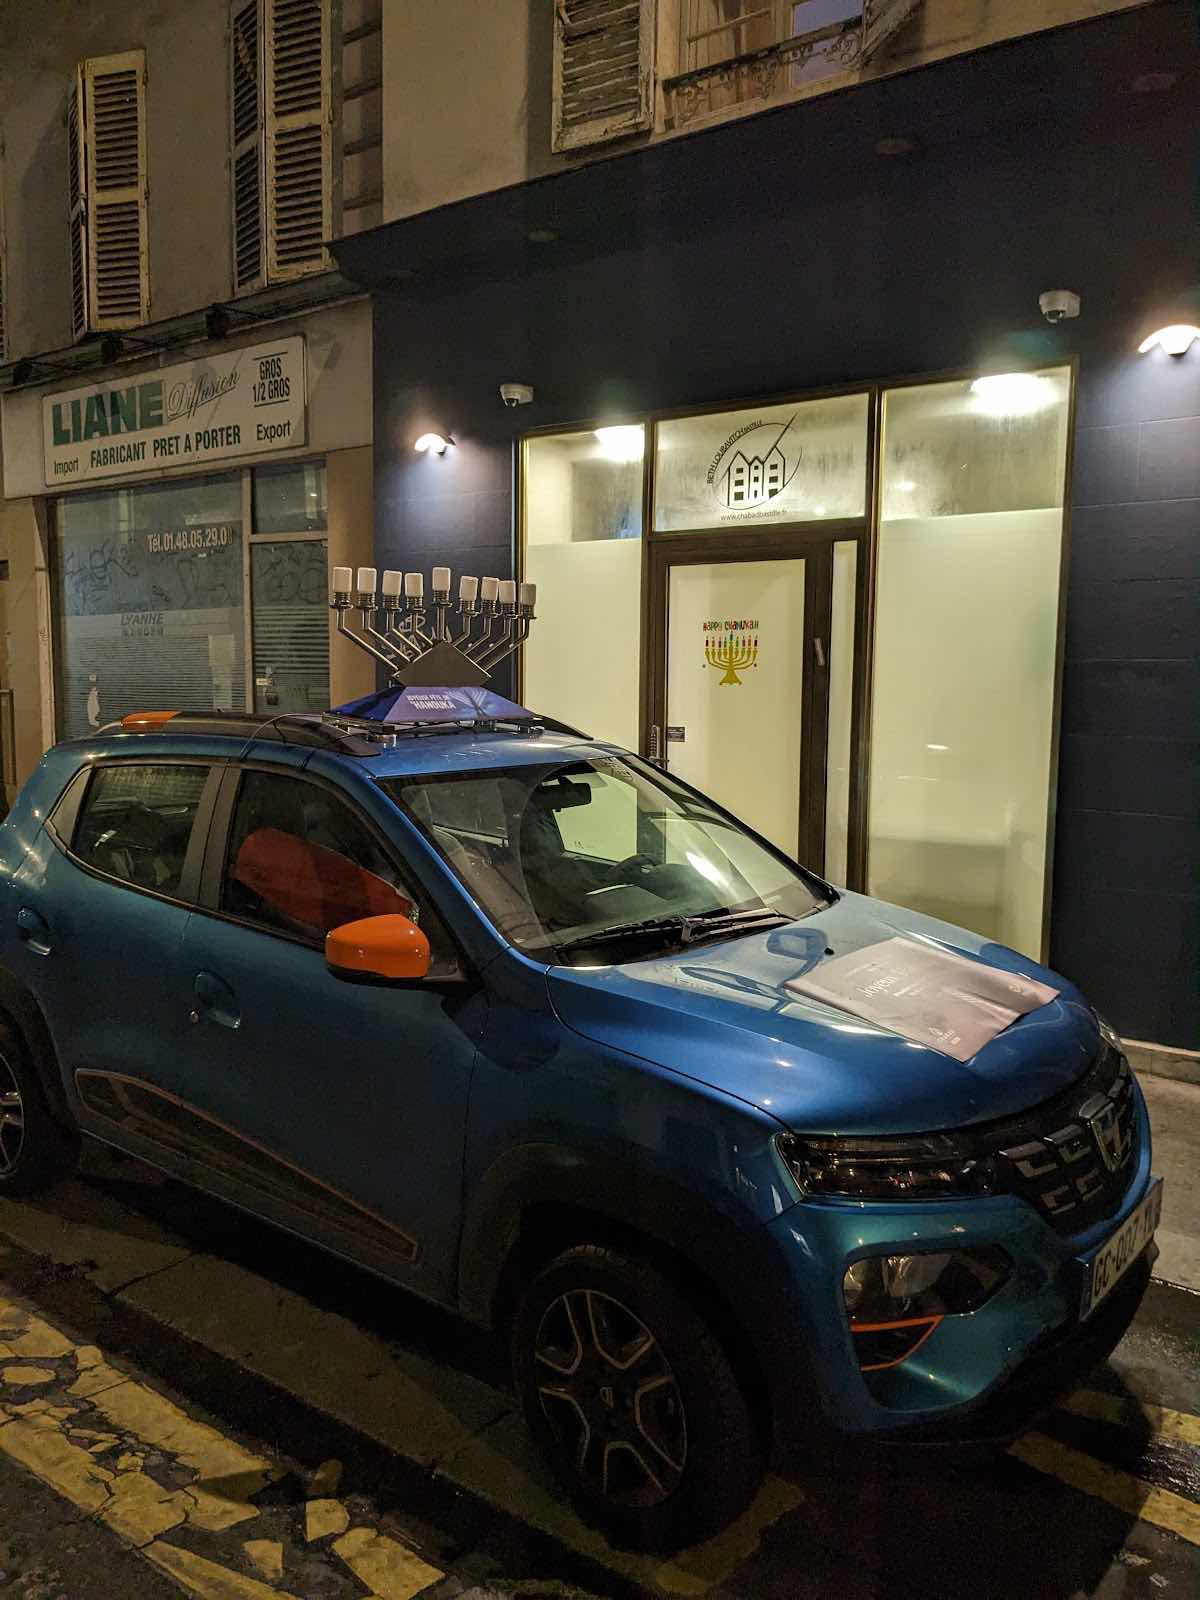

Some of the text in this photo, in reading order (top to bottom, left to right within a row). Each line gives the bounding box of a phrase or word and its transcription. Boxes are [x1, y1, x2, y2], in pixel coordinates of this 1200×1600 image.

[258, 357, 283, 380] GROS
[252, 378, 291, 403] 1/2 GROS
[52, 379, 166, 447] LIANE
[54, 419, 291, 476] Import FABRICANT PRET A PORTER Export
